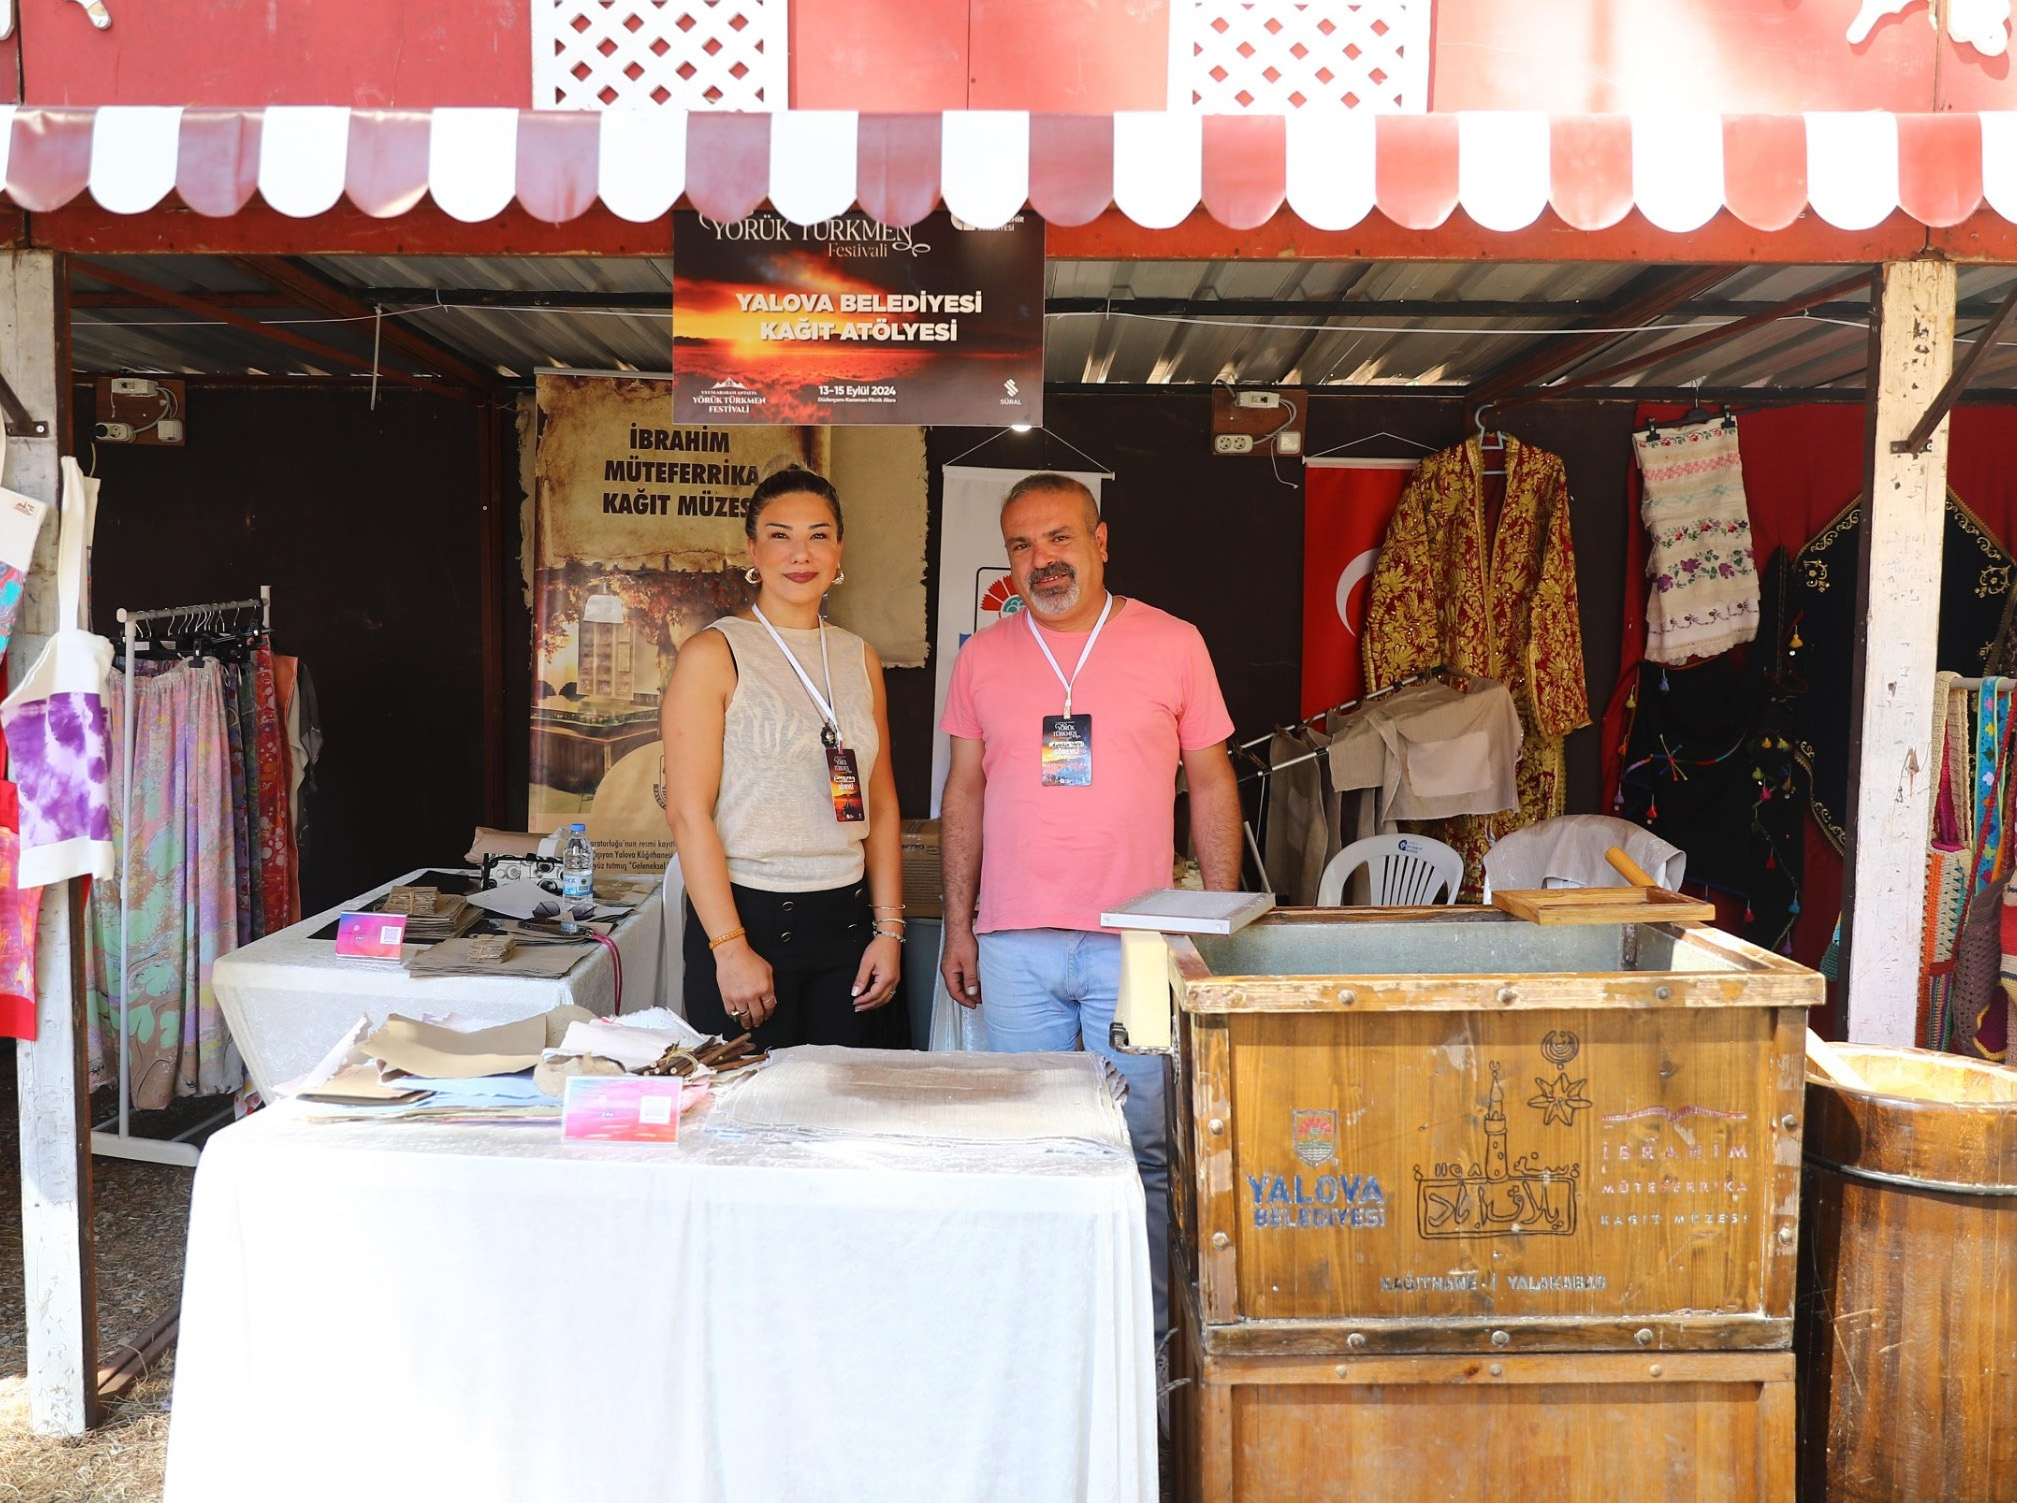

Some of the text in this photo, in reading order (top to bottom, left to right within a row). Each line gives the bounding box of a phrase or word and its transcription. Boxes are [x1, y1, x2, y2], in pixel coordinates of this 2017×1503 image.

[828, 242, 888, 258] Festivali
[735, 290, 982, 314] YALOVA BELEDİYESİ
[760, 317, 958, 342] KAĞIT ATÖLYESİ
[818, 385, 896, 397] 13-15 Eylül 2024
[708, 404, 750, 413] FESTİVALİ
[629, 422, 730, 454] İBRAHİM
[604, 455, 759, 486] MÜTEFERRİKA
[602, 487, 751, 518] KAĞIT MÜZES
[615, 851, 636, 859] Yalova
[1247, 1174, 1385, 1205] YALOVA
